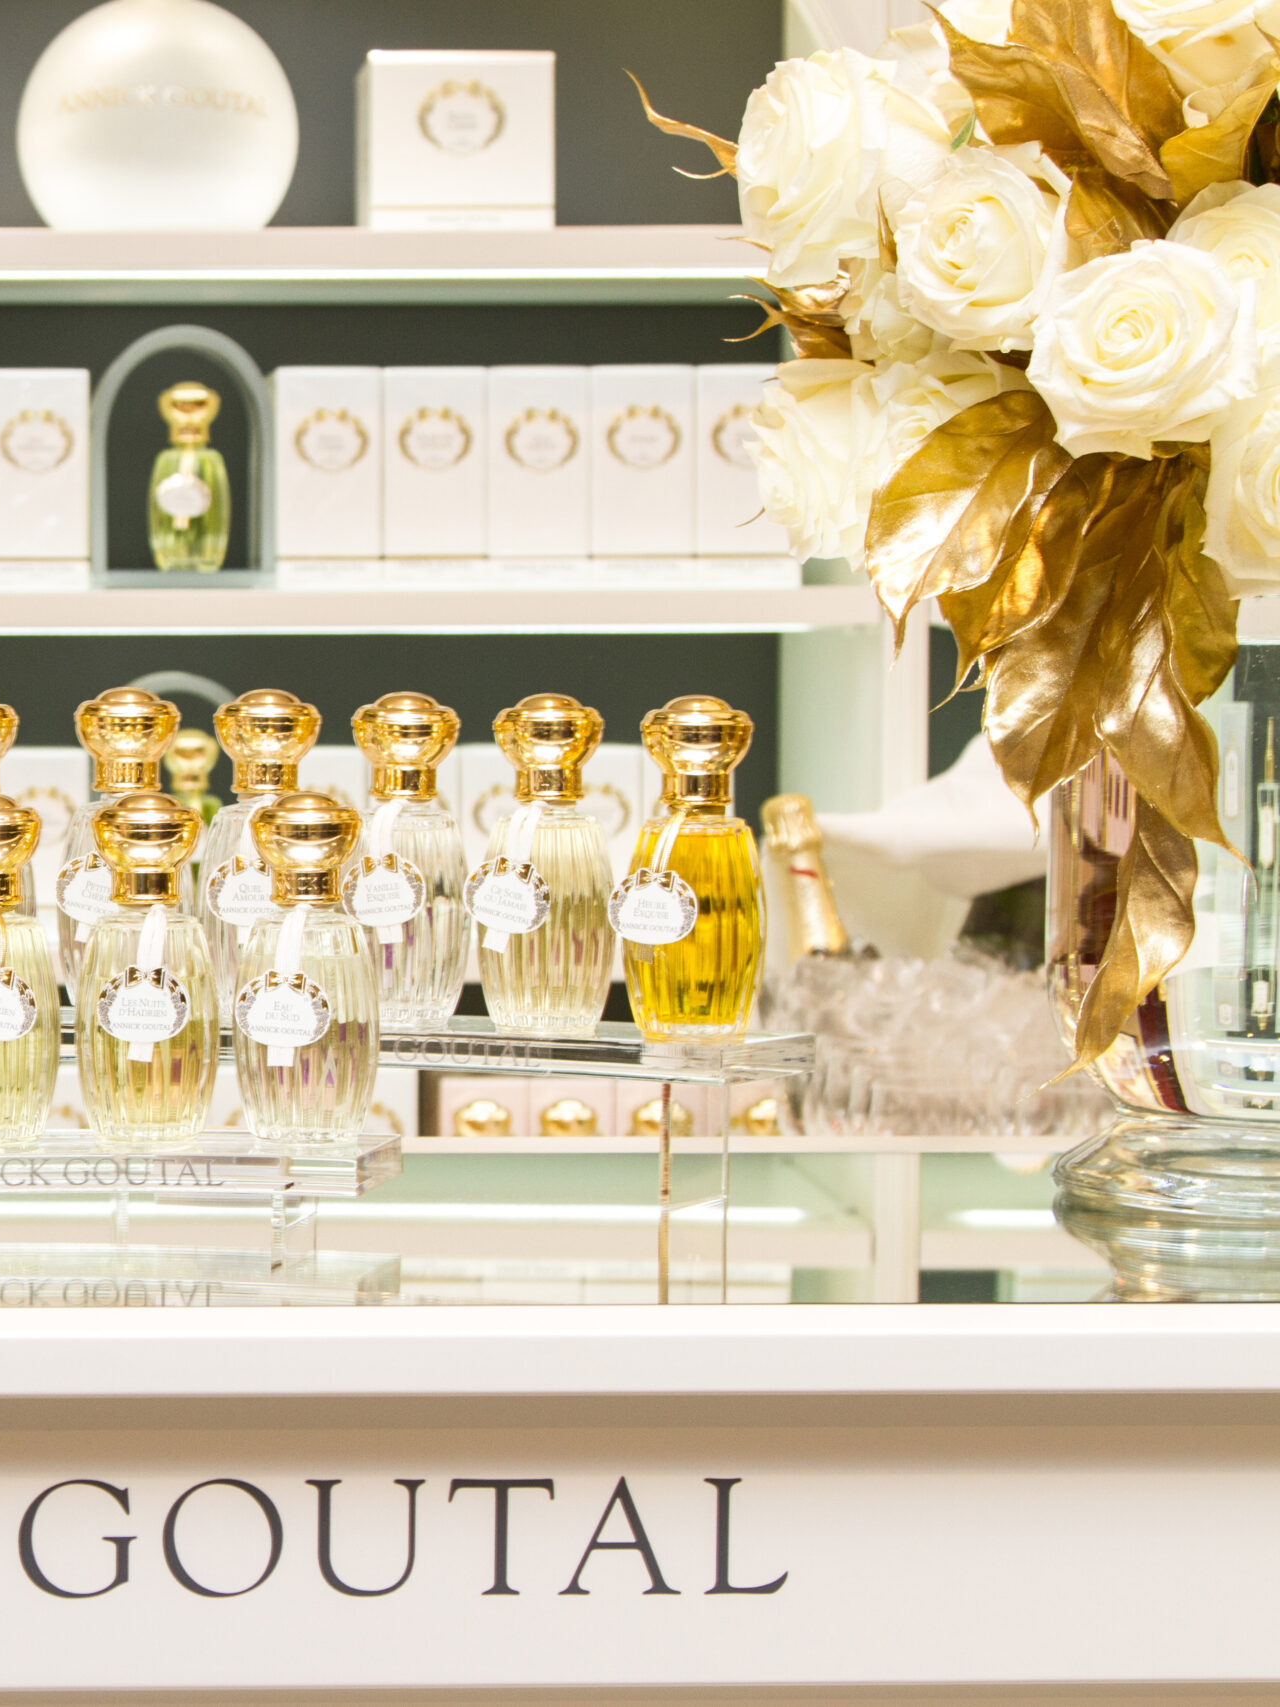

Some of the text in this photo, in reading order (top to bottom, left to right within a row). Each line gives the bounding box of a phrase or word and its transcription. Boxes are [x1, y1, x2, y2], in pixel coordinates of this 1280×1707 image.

[238, 883, 264, 894] QUEL
[365, 882, 401, 892] VANILLE
[637, 897, 669, 910] HEURE
[357, 904, 413, 915] ANNICK GOUTAL
[475, 906, 529, 925] ANNICK GOUTAL
[621, 921, 679, 932] ANNICK GOUTAL
[121, 997, 169, 1008] LES NUITS
[274, 1001, 294, 1012] EAU
[280, 1011, 301, 1022] SUD
[112, 1022, 171, 1031] ANNICK GOUTAL
[249, 1025, 313, 1037] ANNICK GOUTAL
[392, 1036, 541, 1068] GOUTAL
[63, 1157, 225, 1187] GOUTAL
[18, 1475, 789, 1600] GOUTAL
